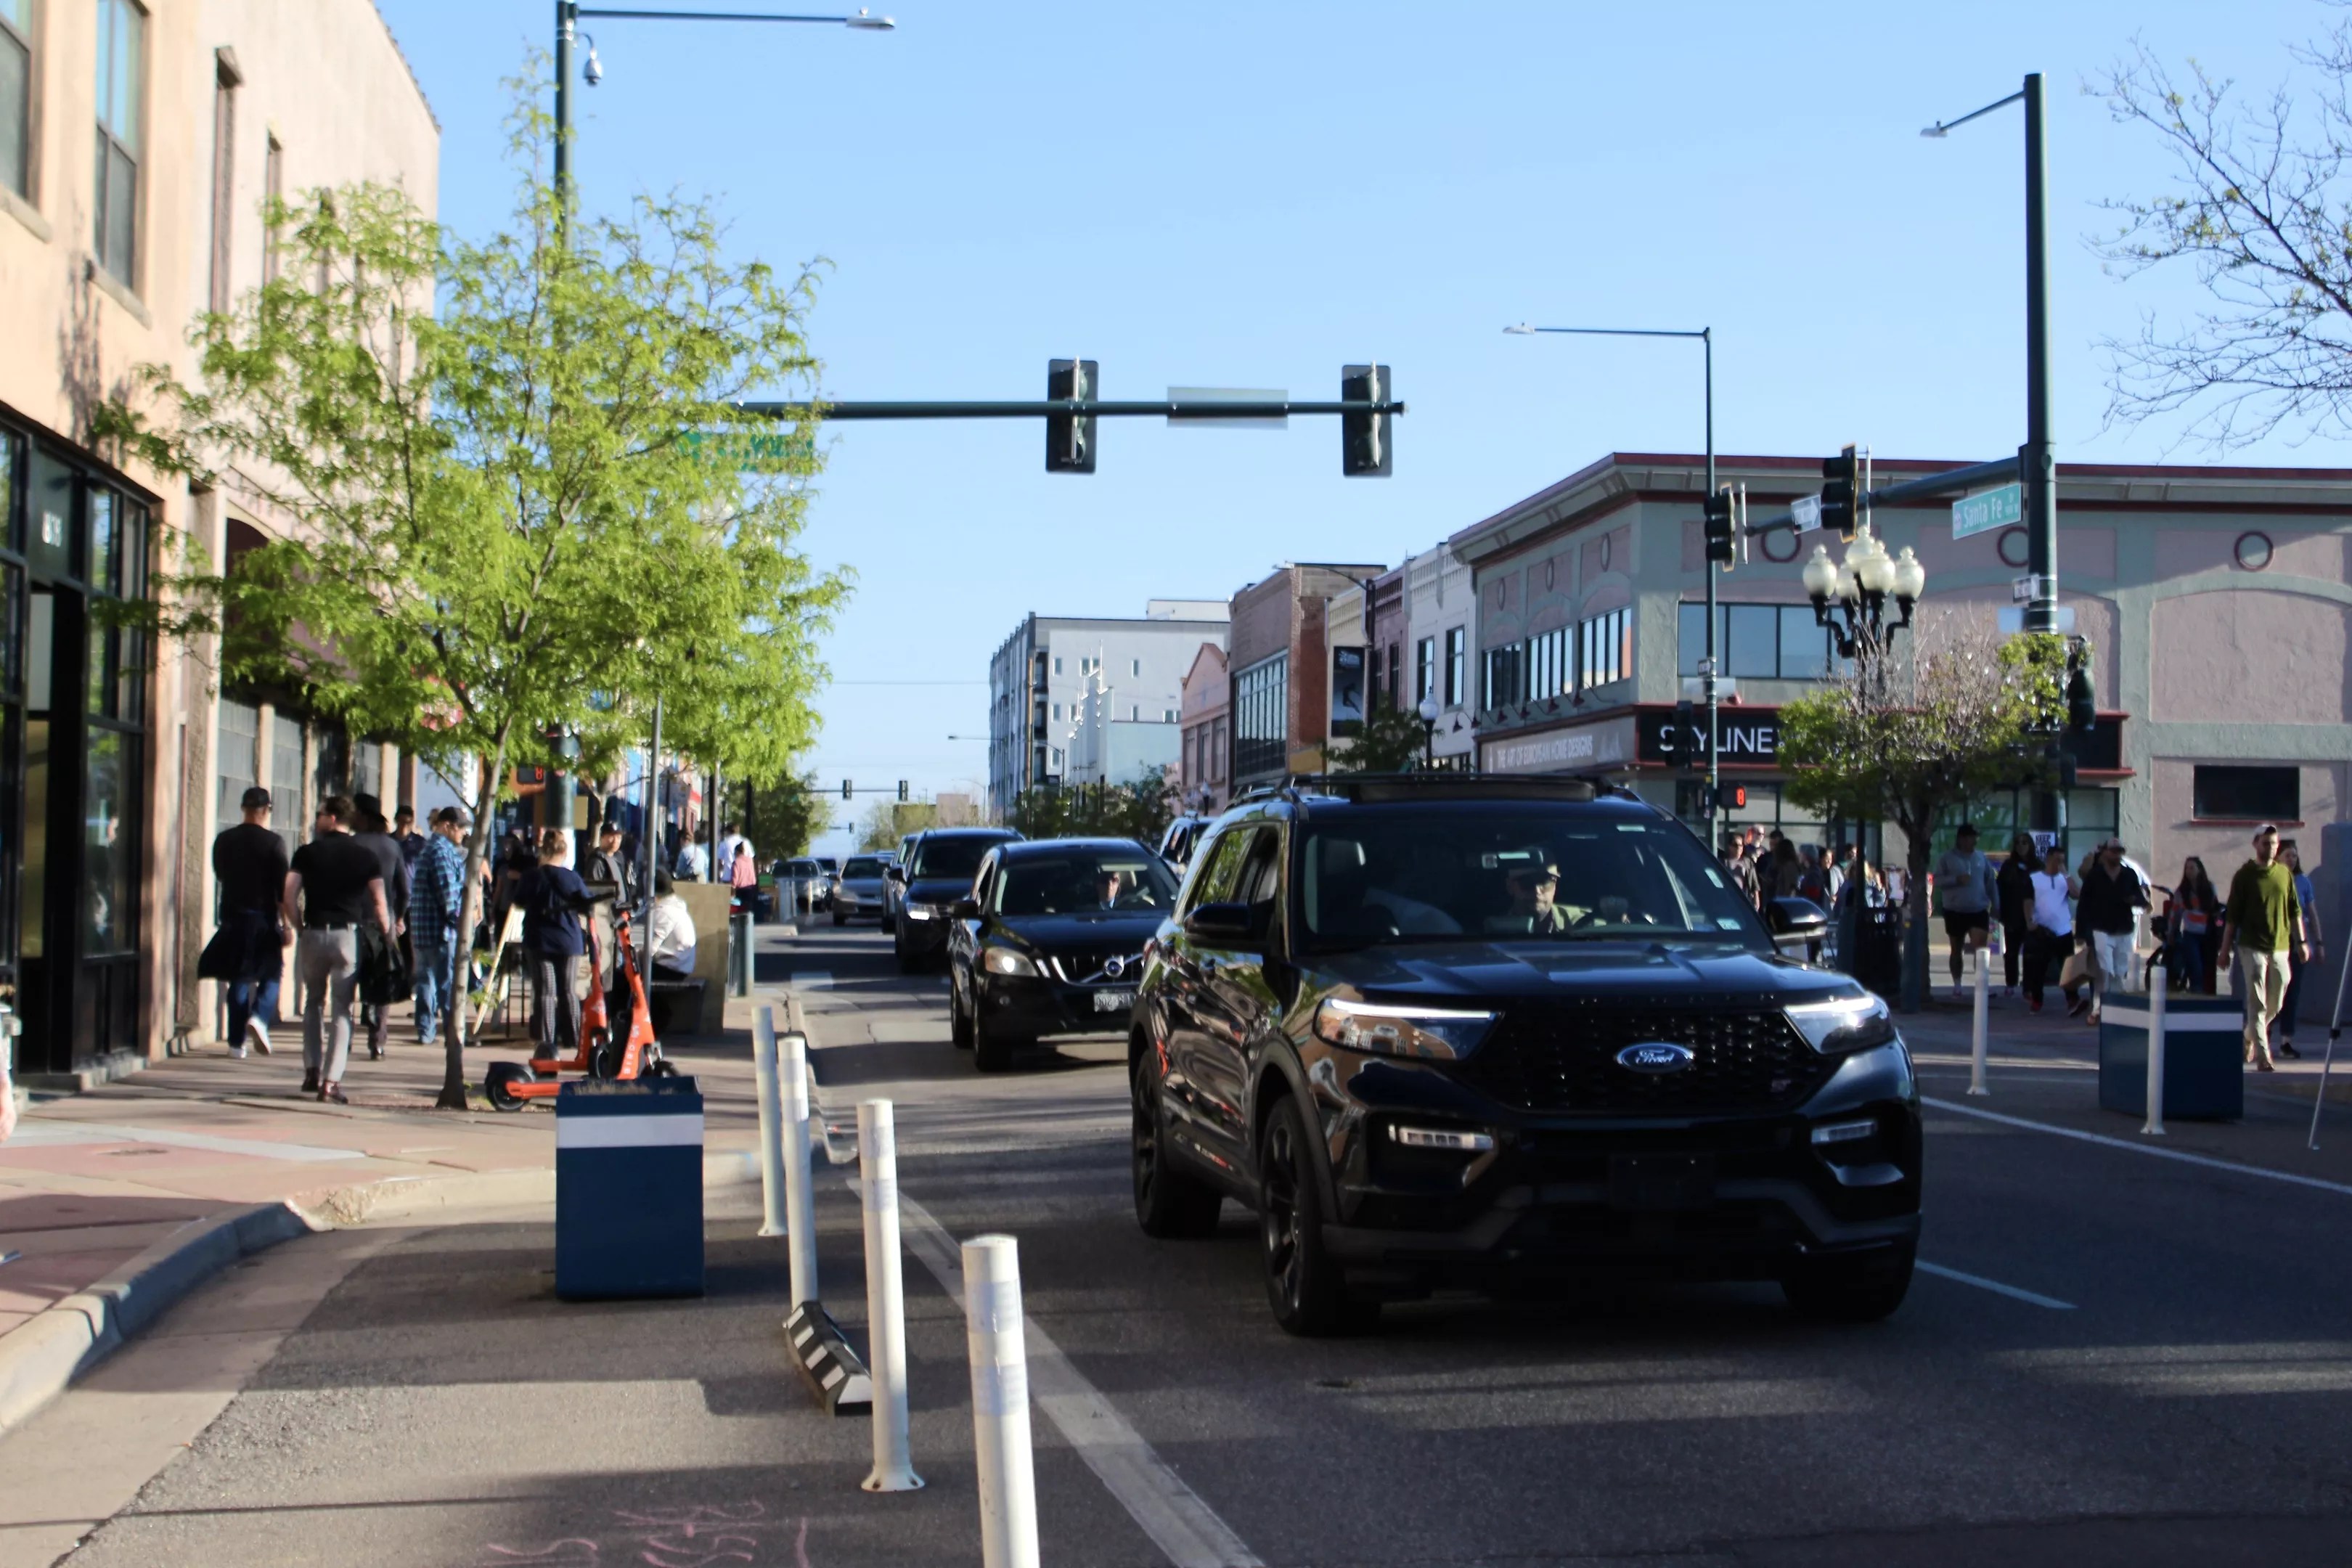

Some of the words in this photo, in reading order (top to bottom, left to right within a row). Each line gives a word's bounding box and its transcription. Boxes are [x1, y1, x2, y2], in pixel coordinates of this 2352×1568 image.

[1964, 502, 1988, 528] Santa
[1991, 496, 2002, 519] Fe
[1507, 747, 1516, 767] ART
[1516, 746, 1524, 766] OF
[1551, 738, 1568, 760] HOME
[1569, 735, 1593, 757] DESIGNS
[1659, 724, 1773, 754] SYINE
[1736, 786, 1745, 807] 8
[1635, 1049, 1675, 1063] Ford
